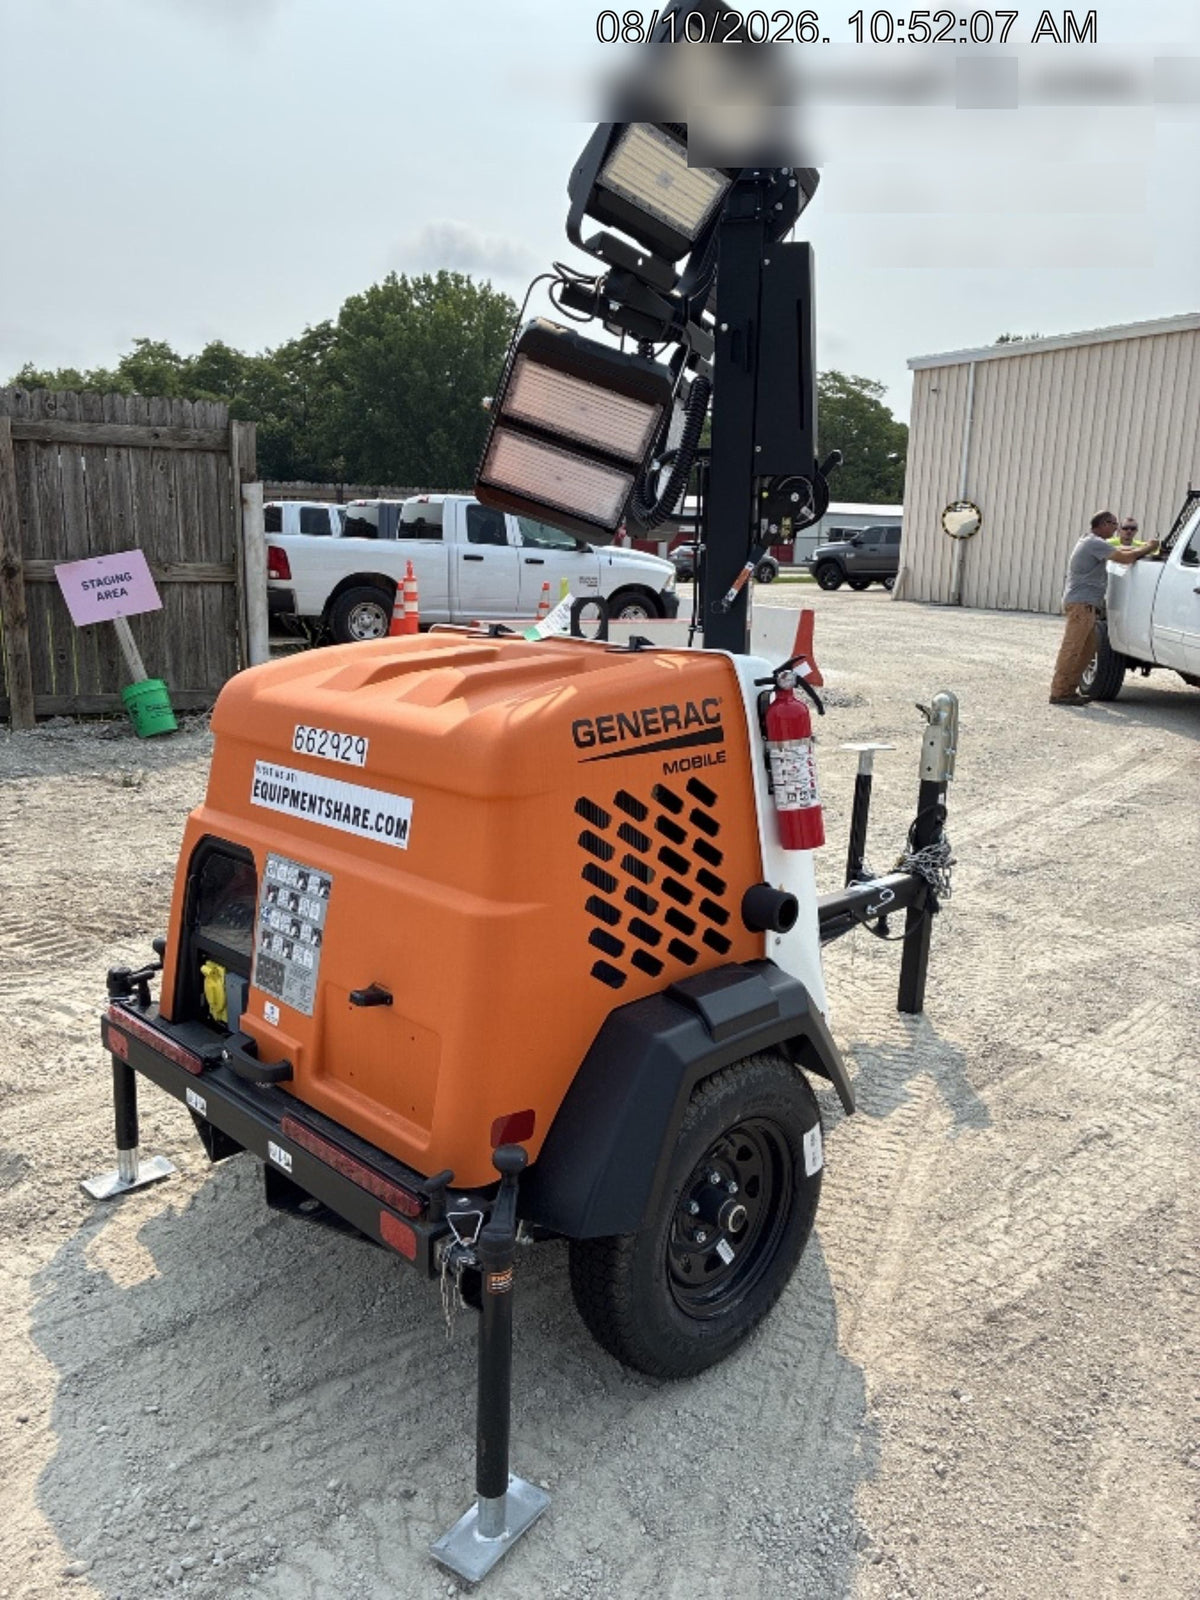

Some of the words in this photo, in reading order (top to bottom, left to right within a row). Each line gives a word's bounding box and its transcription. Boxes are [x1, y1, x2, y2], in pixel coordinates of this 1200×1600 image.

[81, 572, 133, 591] STAGING
[97, 587, 128, 601] AREA
[572, 698, 721, 748] GENERAC
[294, 726, 366, 764] 662929
[662, 750, 727, 775] MOBILE
[253, 778, 408, 840] EQUIPMENTSHARE.COM
